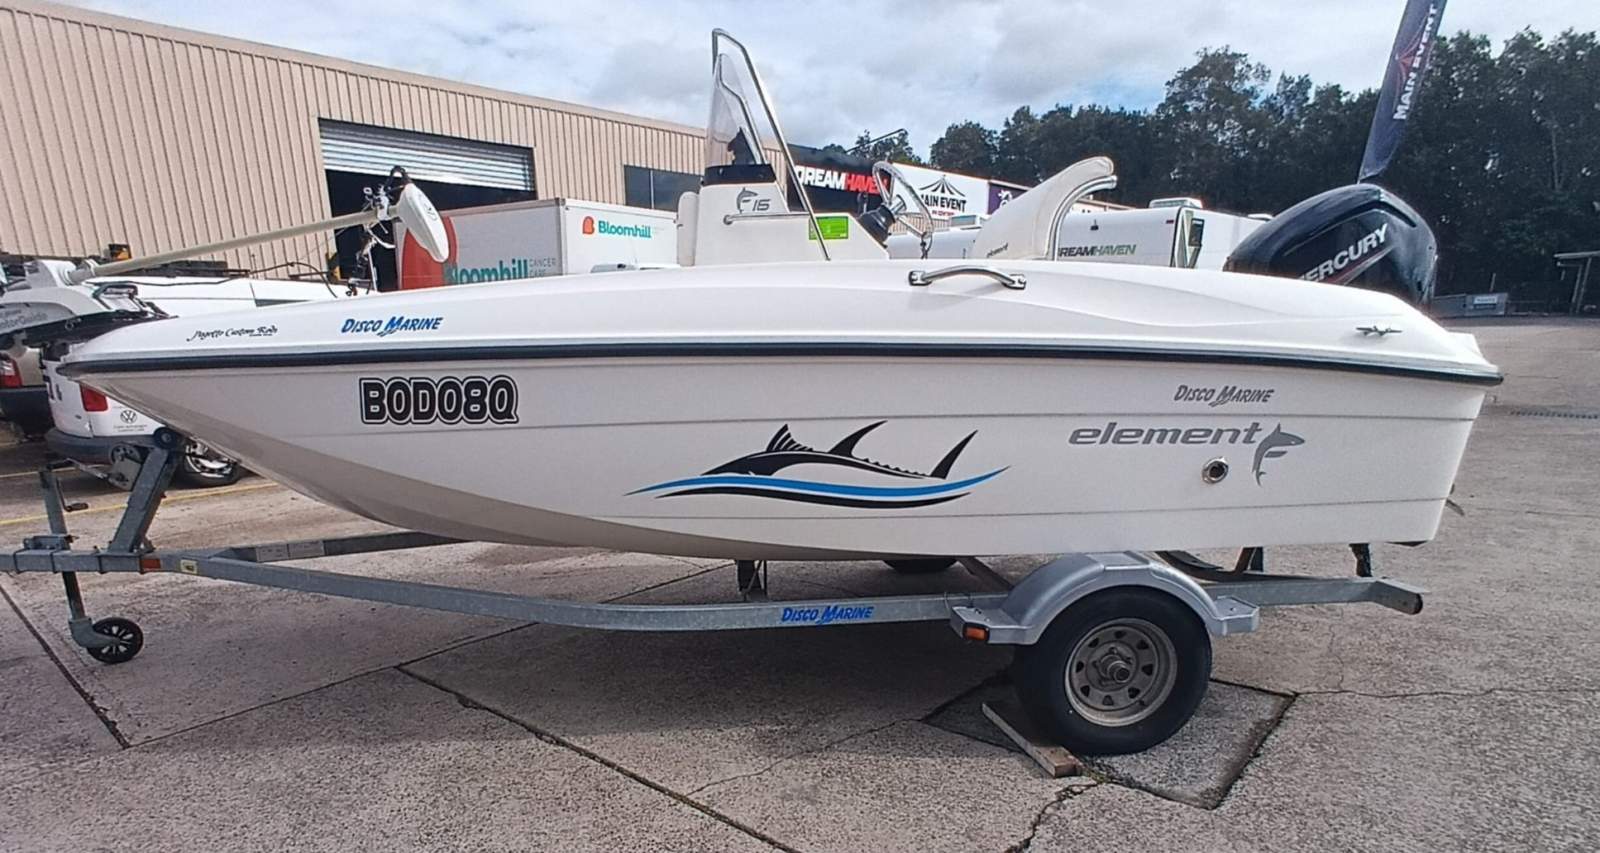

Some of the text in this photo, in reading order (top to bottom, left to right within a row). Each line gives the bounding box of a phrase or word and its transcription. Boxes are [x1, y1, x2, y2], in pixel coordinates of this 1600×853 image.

[1393, 4, 1437, 119] MAIN EVENT
[921, 194, 967, 212] AIN EVENT
[598, 220, 651, 238] Bloomhill
[1059, 244, 1136, 257] REAMHAVEN
[1300, 223, 1388, 282] ERCURY
[1068, 422, 1263, 445] element
